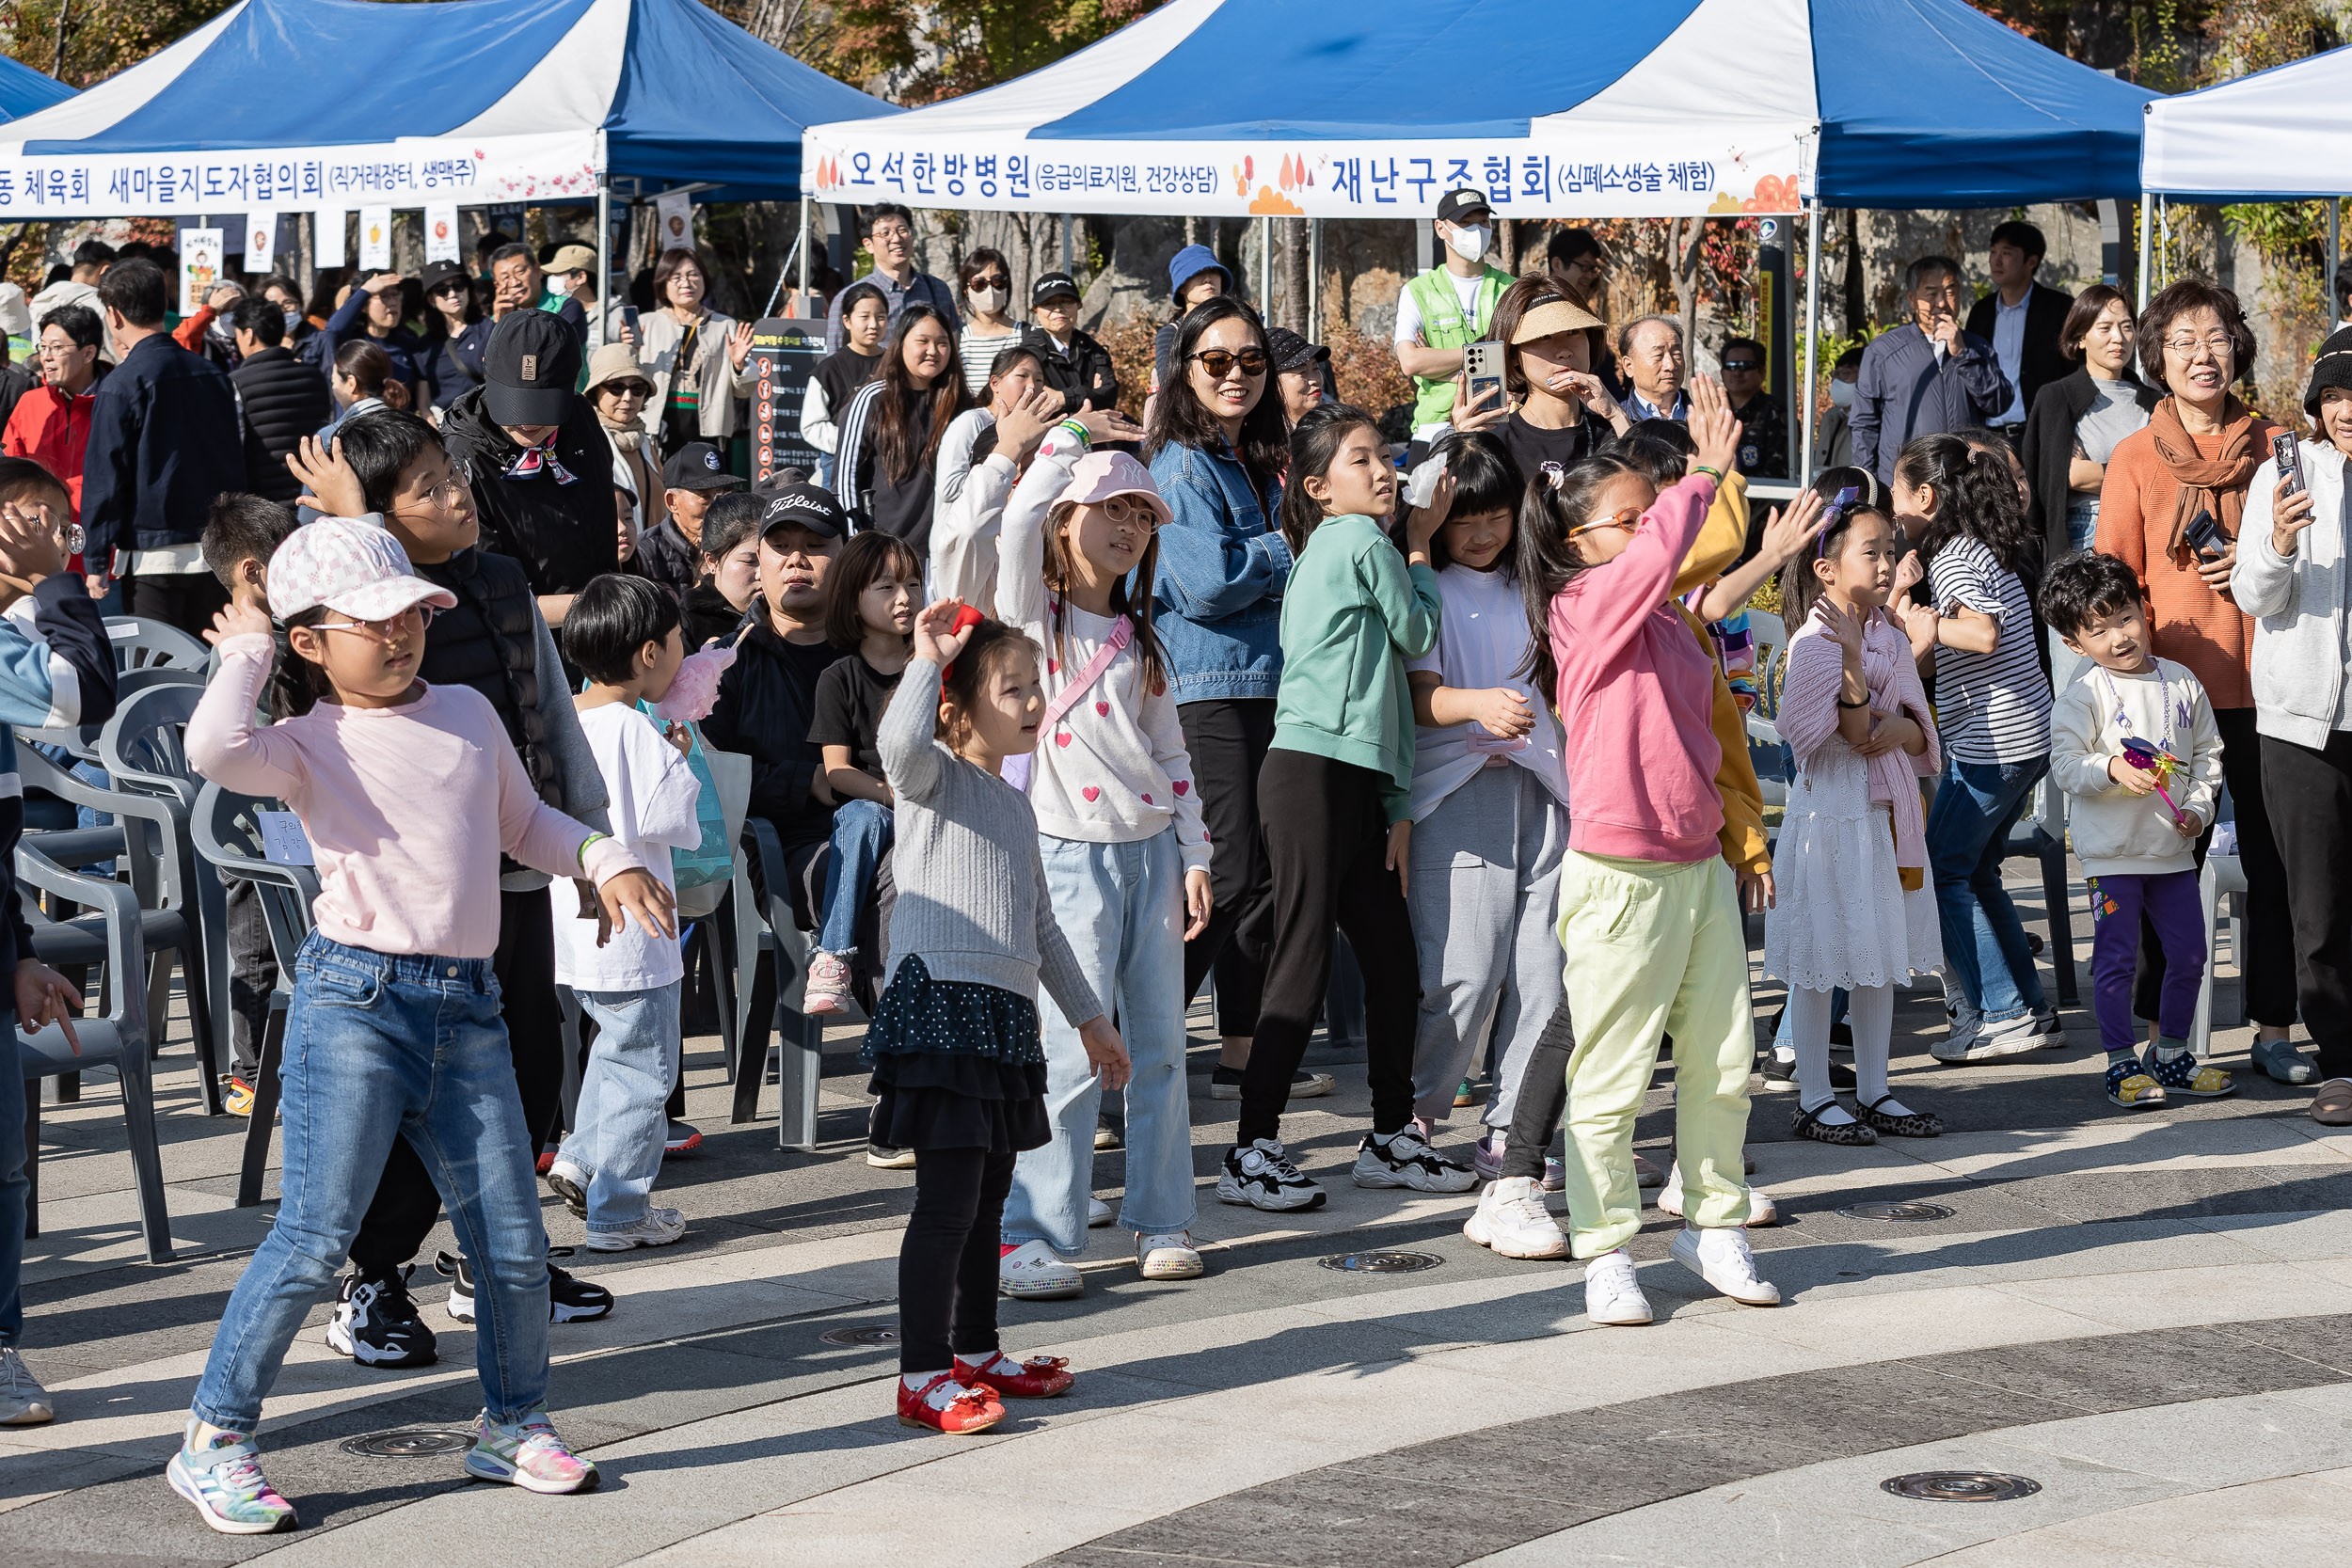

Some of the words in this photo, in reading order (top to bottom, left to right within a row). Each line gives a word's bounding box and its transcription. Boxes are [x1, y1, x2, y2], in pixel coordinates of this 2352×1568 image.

[24, 167, 89, 205] 체육회
[108, 161, 322, 204] 새마을지도자협의회
[329, 163, 418, 193] (직거래장터,
[422, 159, 476, 187] 생맥주)
[850, 151, 1030, 198] 오석한방병원
[1035, 163, 1141, 194] (응급의료지원,
[1146, 165, 1218, 195] 건강상담)
[1331, 155, 1551, 204] 재난구조협회
[1558, 163, 1662, 195] (심폐소생술
[1667, 161, 1715, 192] 체험)
[1121, 461, 1143, 486] NY
[766, 493, 833, 519] Titleist
